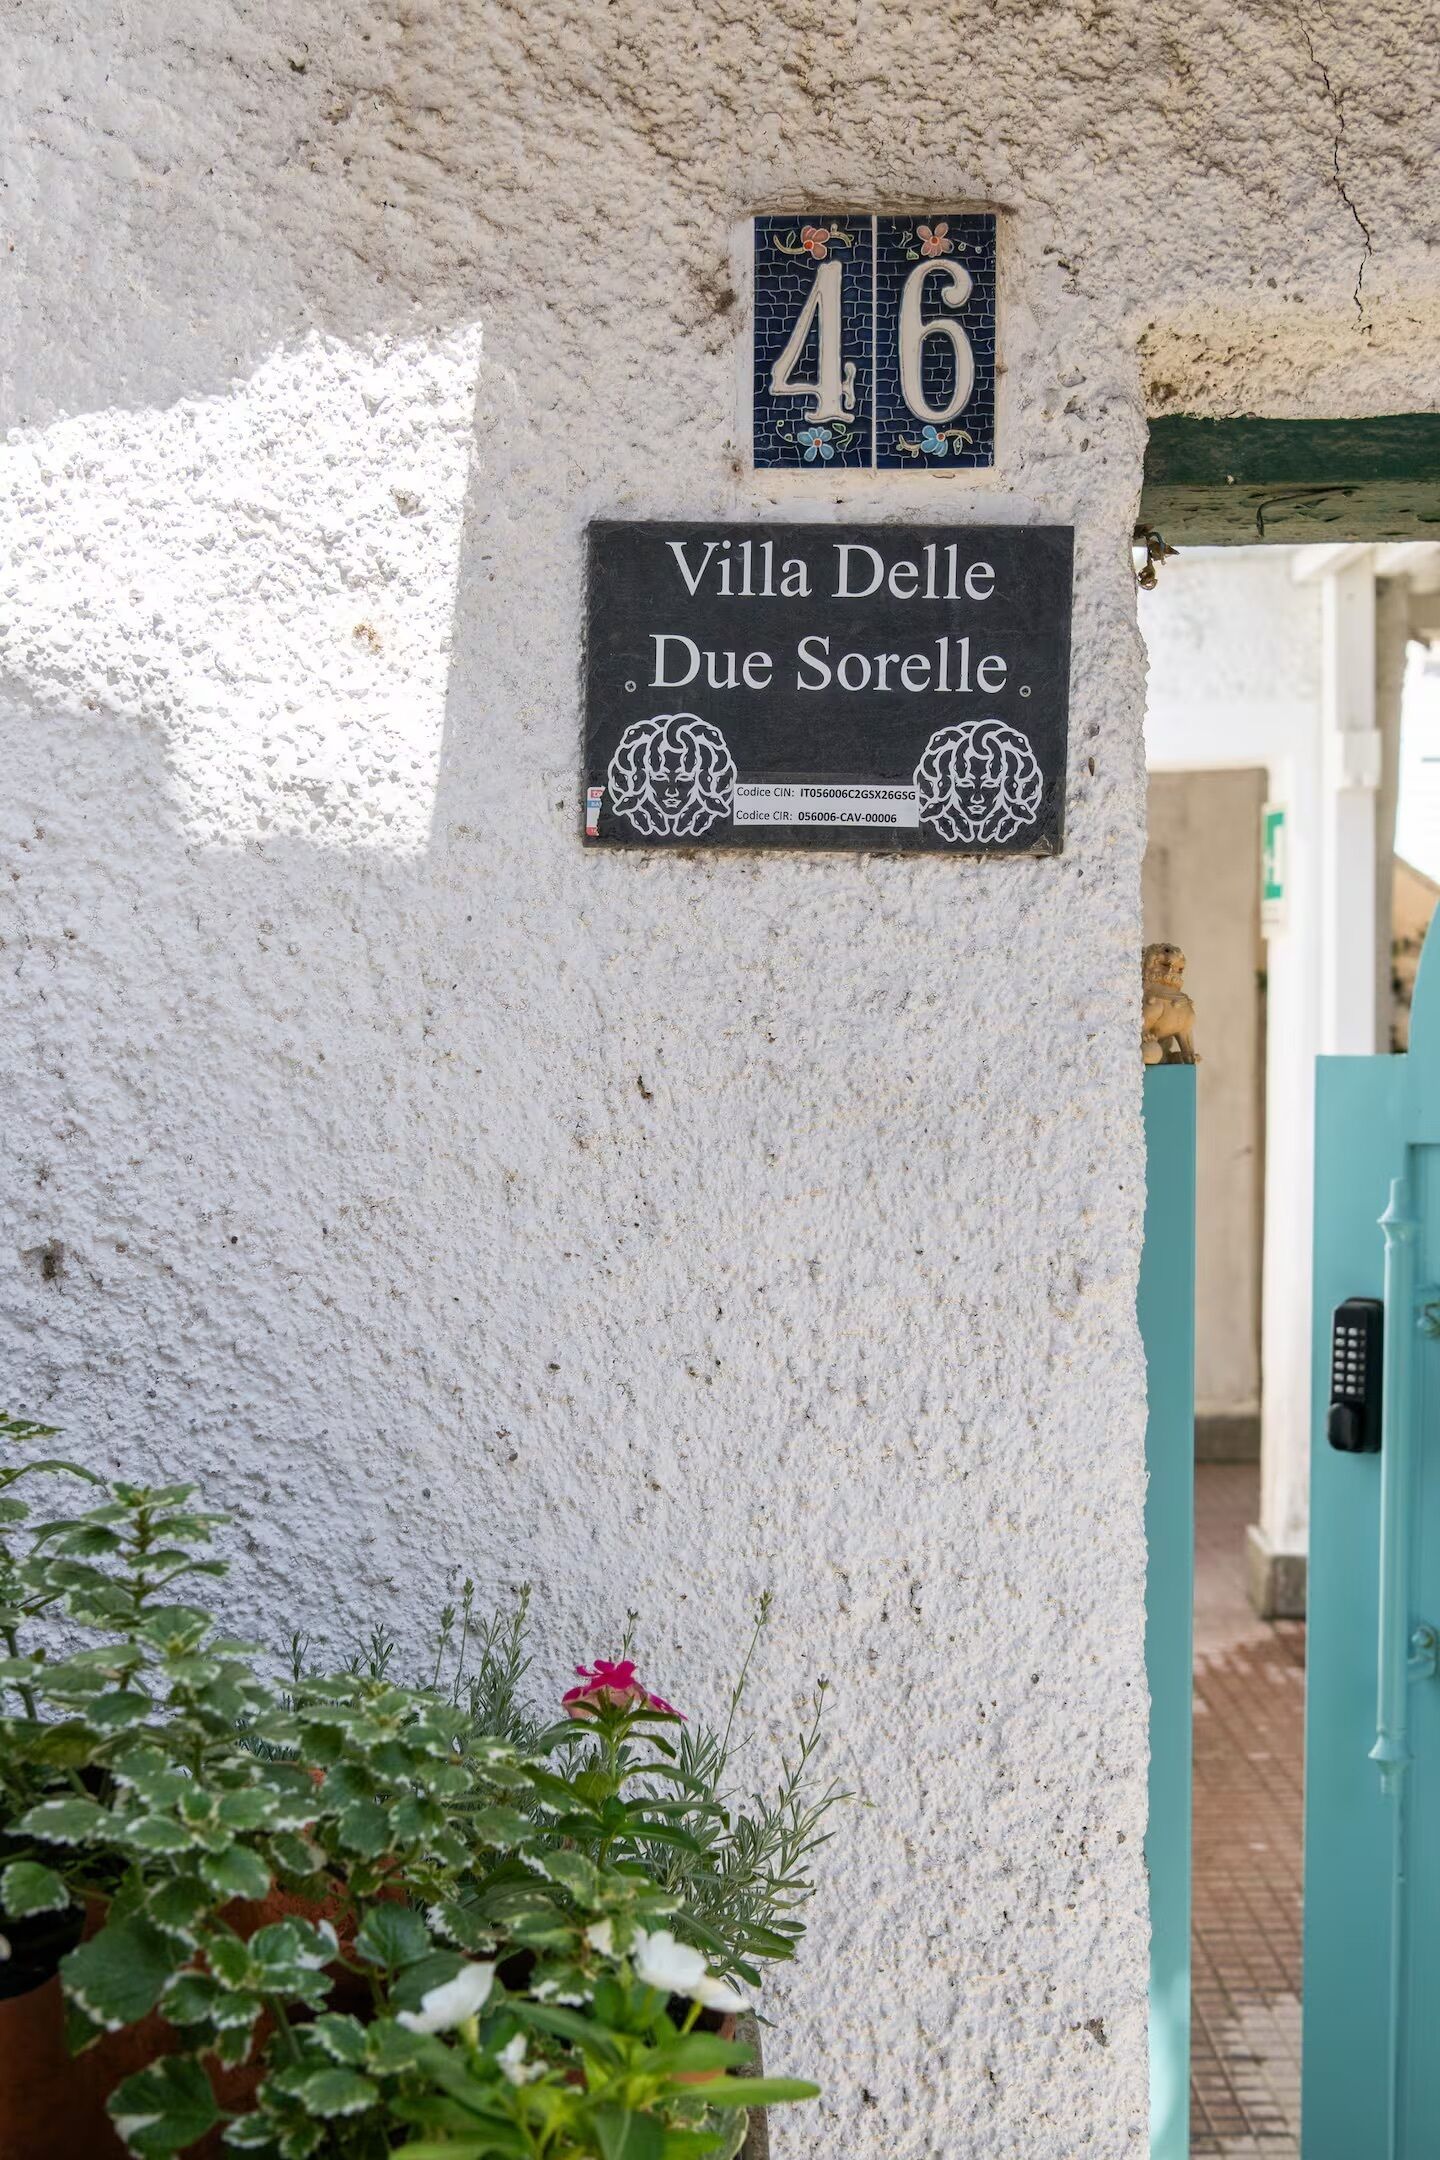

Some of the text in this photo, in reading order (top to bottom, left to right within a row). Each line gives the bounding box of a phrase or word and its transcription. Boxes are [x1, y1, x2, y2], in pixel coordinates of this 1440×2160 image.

[769, 259, 975, 424] 46
[665, 540, 995, 601] Villa Delle
[648, 634, 1008, 694] Due Sorelle
[736, 786, 916, 801] Codice CIN: IT056006C2GSX26GSG
[736, 810, 897, 823] Codice CIR: 056006-CAV-00006
